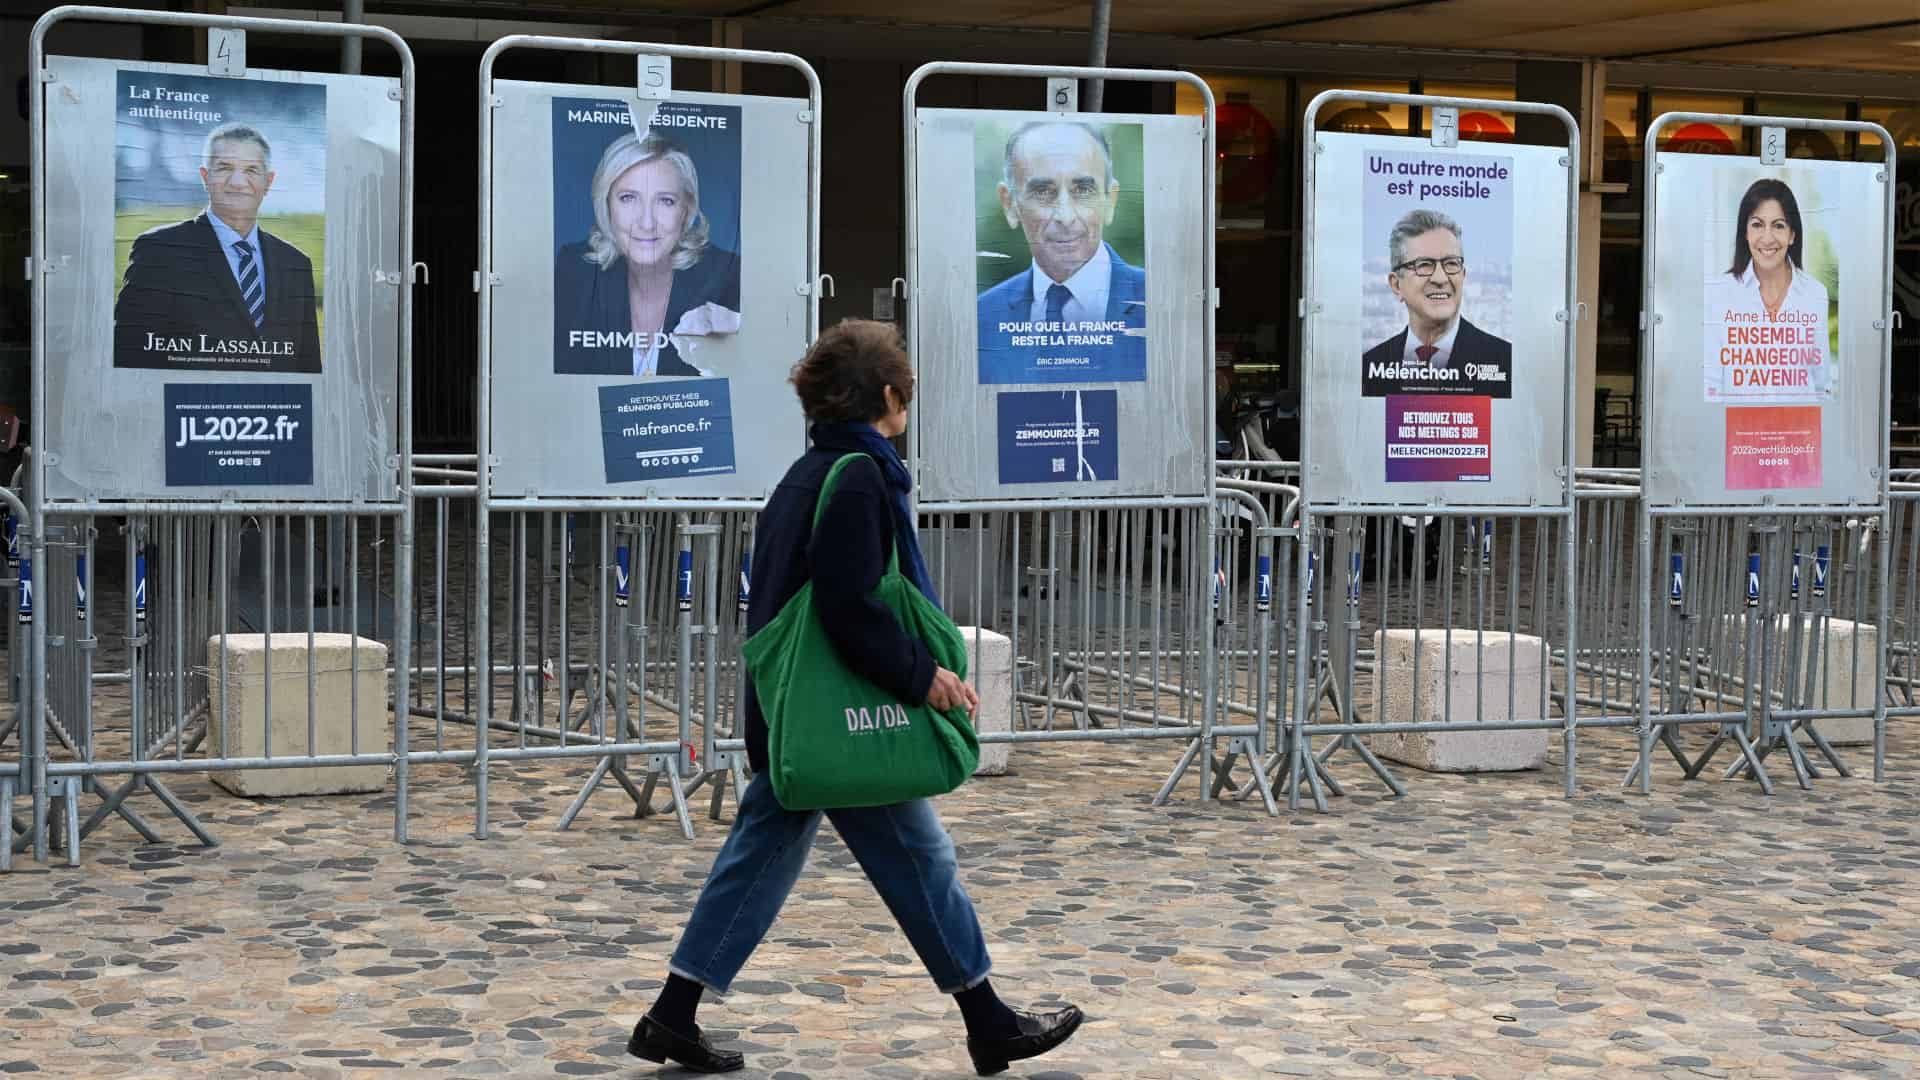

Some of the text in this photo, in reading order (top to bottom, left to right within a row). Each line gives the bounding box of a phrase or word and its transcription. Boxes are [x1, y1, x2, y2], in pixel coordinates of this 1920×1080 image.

[216, 35, 230, 64] 4
[645, 65, 664, 87] 5
[129, 85, 209, 103] La France
[1056, 86, 1070, 105] 6
[129, 105, 222, 124] authentique
[568, 110, 630, 125] MARINE
[1440, 114, 1454, 137] 7
[1768, 134, 1777, 156] 8
[1370, 156, 1508, 180] Un autre monde
[1387, 179, 1491, 200] est possible
[999, 321, 1126, 333] POUR QUE LA FRANCE
[1724, 309, 1818, 326] Anne Hidalgo
[569, 330, 649, 349] FEMME
[1012, 335, 1114, 346] RESTE LA FRANCE
[1727, 326, 1815, 345] ENSEMBLE
[1720, 348, 1822, 366] CHANGEONS
[1368, 361, 1459, 380] Mélenchon
[1733, 368, 1808, 387] D'AVENIR
[1403, 411, 1474, 424] RETROUVEZ TOUS
[176, 415, 299, 447] JL2022.fr
[623, 418, 712, 437] mlafrance.fr
[1398, 426, 1479, 439] NOS MEETINGS SUR
[1390, 446, 1487, 457] MELENCHON2022.FR
[845, 703, 911, 731] DA/DA
